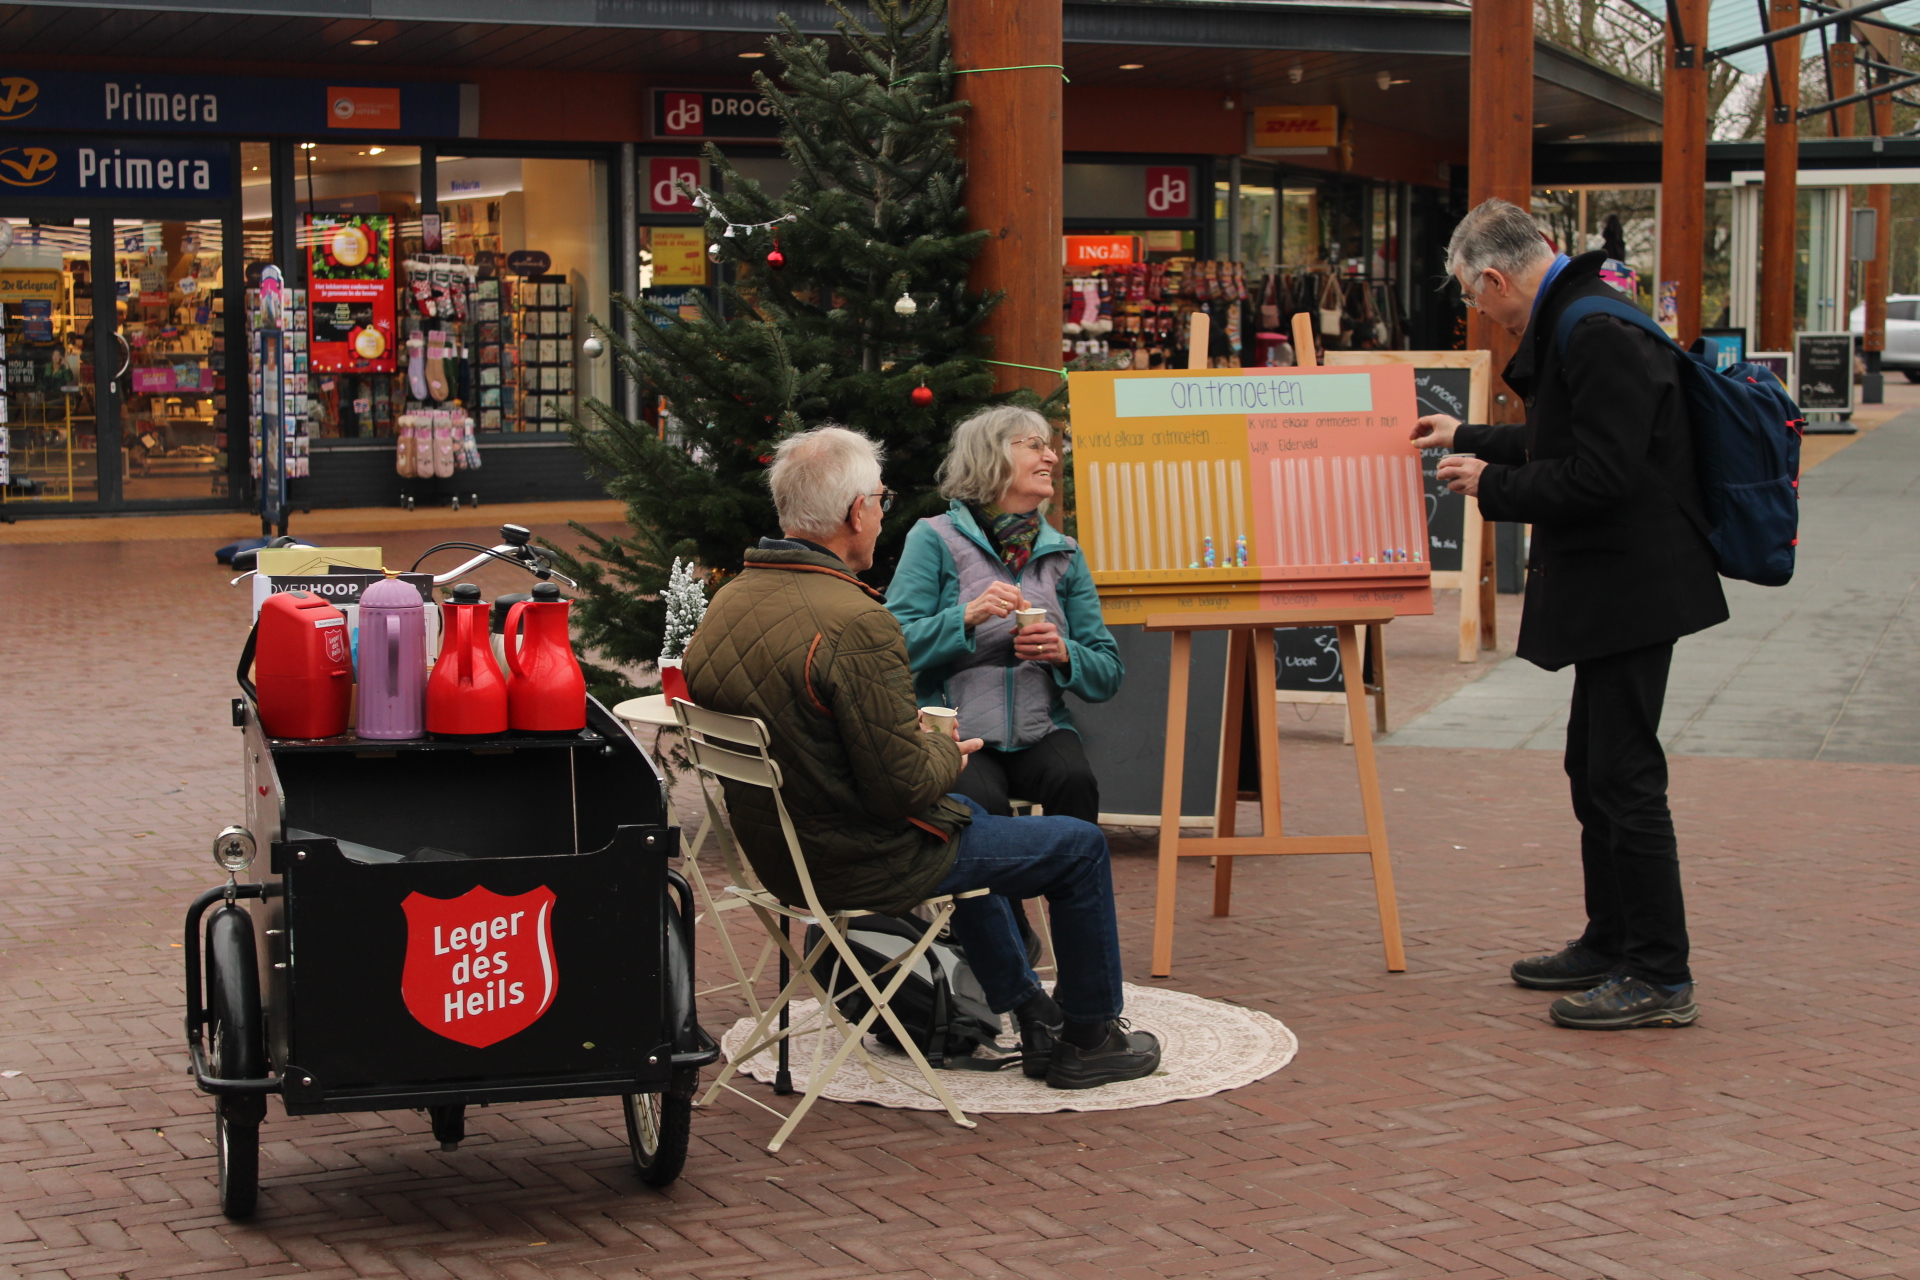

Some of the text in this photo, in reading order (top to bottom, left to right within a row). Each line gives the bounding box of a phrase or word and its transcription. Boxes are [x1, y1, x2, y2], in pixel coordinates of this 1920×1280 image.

[105, 83, 217, 122] Primera
[711, 98, 777, 116] DROG
[1264, 119, 1322, 133] DHL
[79, 148, 210, 190] Primera
[1148, 174, 1186, 211] da
[1078, 245, 1109, 260] ING
[2, 279, 58, 292] De Telegraaf
[1171, 380, 1304, 408] ontmoeten
[1259, 417, 1277, 429] vind
[1282, 417, 1310, 429] elkaar
[1316, 416, 1360, 428] ontmoeten
[1365, 416, 1374, 427] in
[1089, 430, 1111, 448] vind
[1115, 430, 1145, 447] elkaar
[1151, 428, 1210, 446] ontmoeten
[1278, 438, 1318, 452] Elderveld
[434, 910, 525, 956] Leger
[451, 951, 508, 985] des
[444, 978, 525, 1023] Heils
